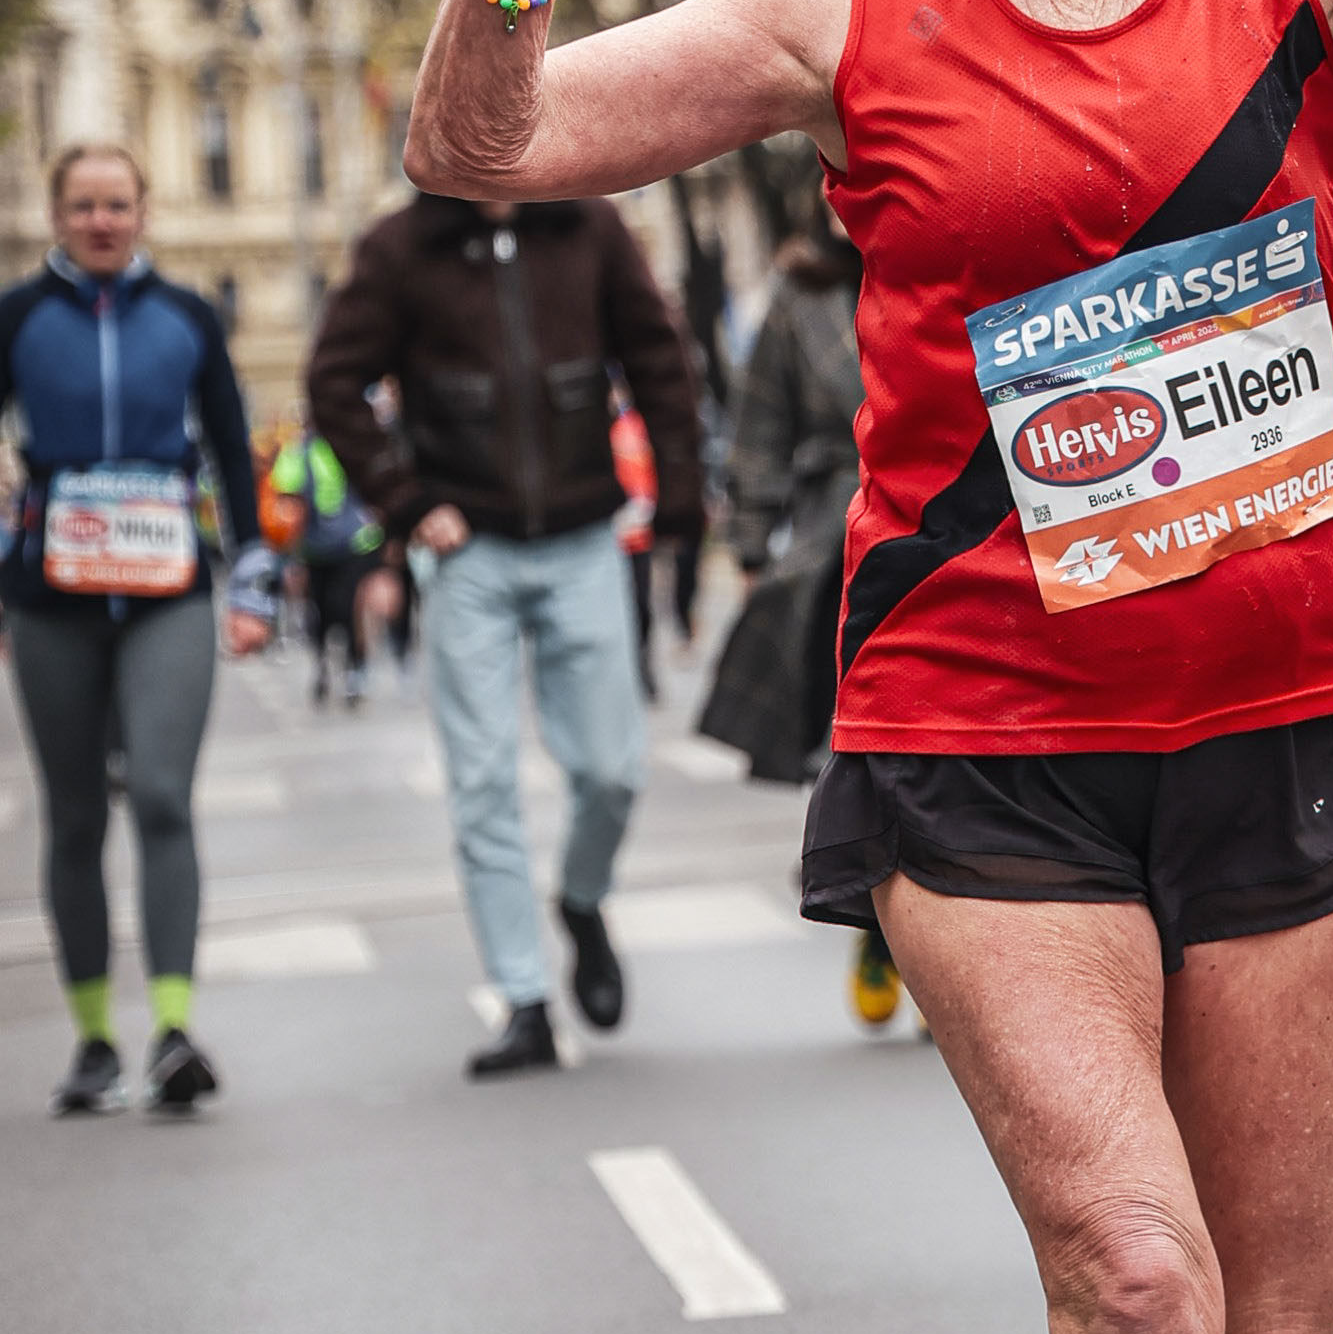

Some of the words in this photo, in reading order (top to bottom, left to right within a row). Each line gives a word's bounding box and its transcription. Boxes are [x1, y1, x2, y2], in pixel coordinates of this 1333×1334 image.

[993, 248, 1259, 367] SPARKASSE
[1044, 368, 1080, 386] VIENNA
[1081, 362, 1104, 377] CITY
[1103, 344, 1154, 369] MARATHON
[1171, 330, 1196, 346] APRIL
[1197, 322, 1219, 338] 2025
[1164, 347, 1320, 441] Eileen
[1024, 405, 1156, 469] Hervis
[1046, 453, 1106, 478] SPORTS
[1250, 425, 1283, 453] 2936
[1087, 487, 1125, 508] Block
[1125, 483, 1137, 498] E
[1131, 504, 1233, 559] WIEN
